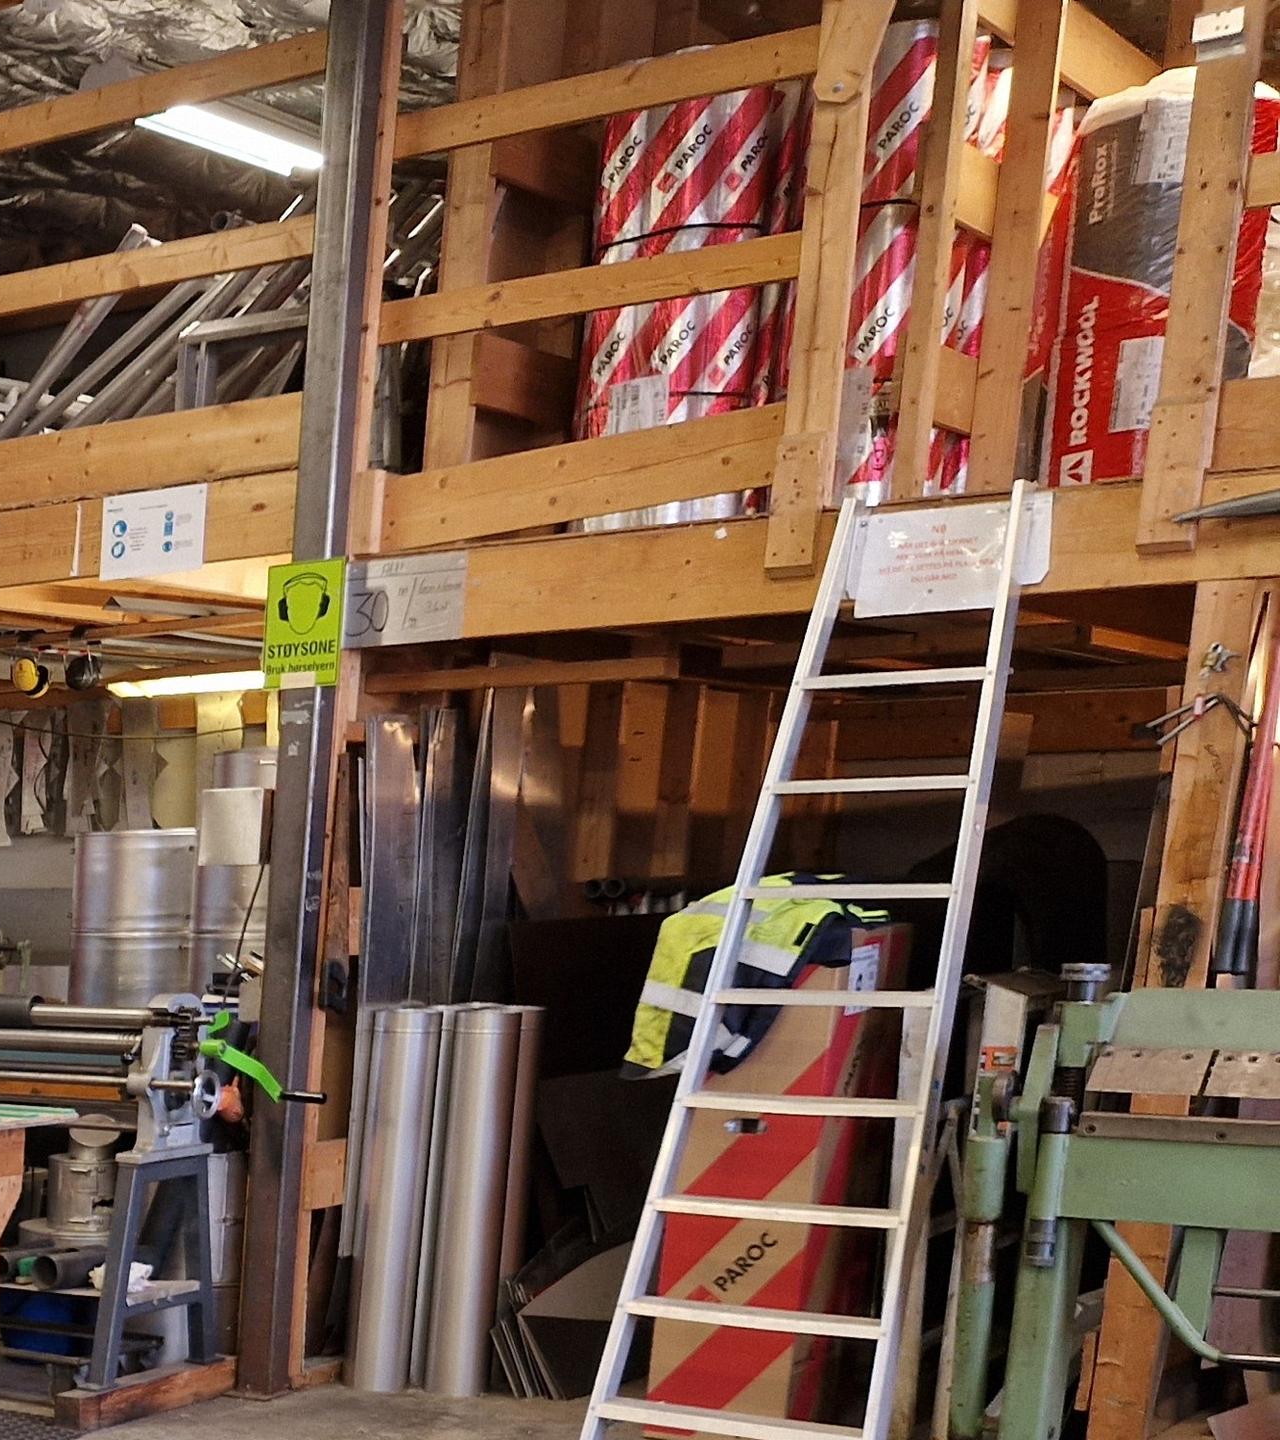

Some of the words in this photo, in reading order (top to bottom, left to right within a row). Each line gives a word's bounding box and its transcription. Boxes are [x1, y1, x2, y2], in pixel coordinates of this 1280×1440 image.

[674, 123, 713, 172] PAROC
[877, 100, 920, 150] PAROC
[608, 135, 643, 184] PAROC
[1087, 144, 1108, 225] ProRox
[659, 320, 696, 366] PAROC
[723, 322, 754, 367] PAROC
[858, 306, 896, 353] PAROC
[596, 331, 626, 377] PAROC
[1069, 295, 1100, 447] ROCKWOOL
[345, 590, 390, 637] 30
[266, 663, 286, 675] Bruk
[267, 639, 336, 659] STØYSONE
[713, 1232, 778, 1292] PAROC
